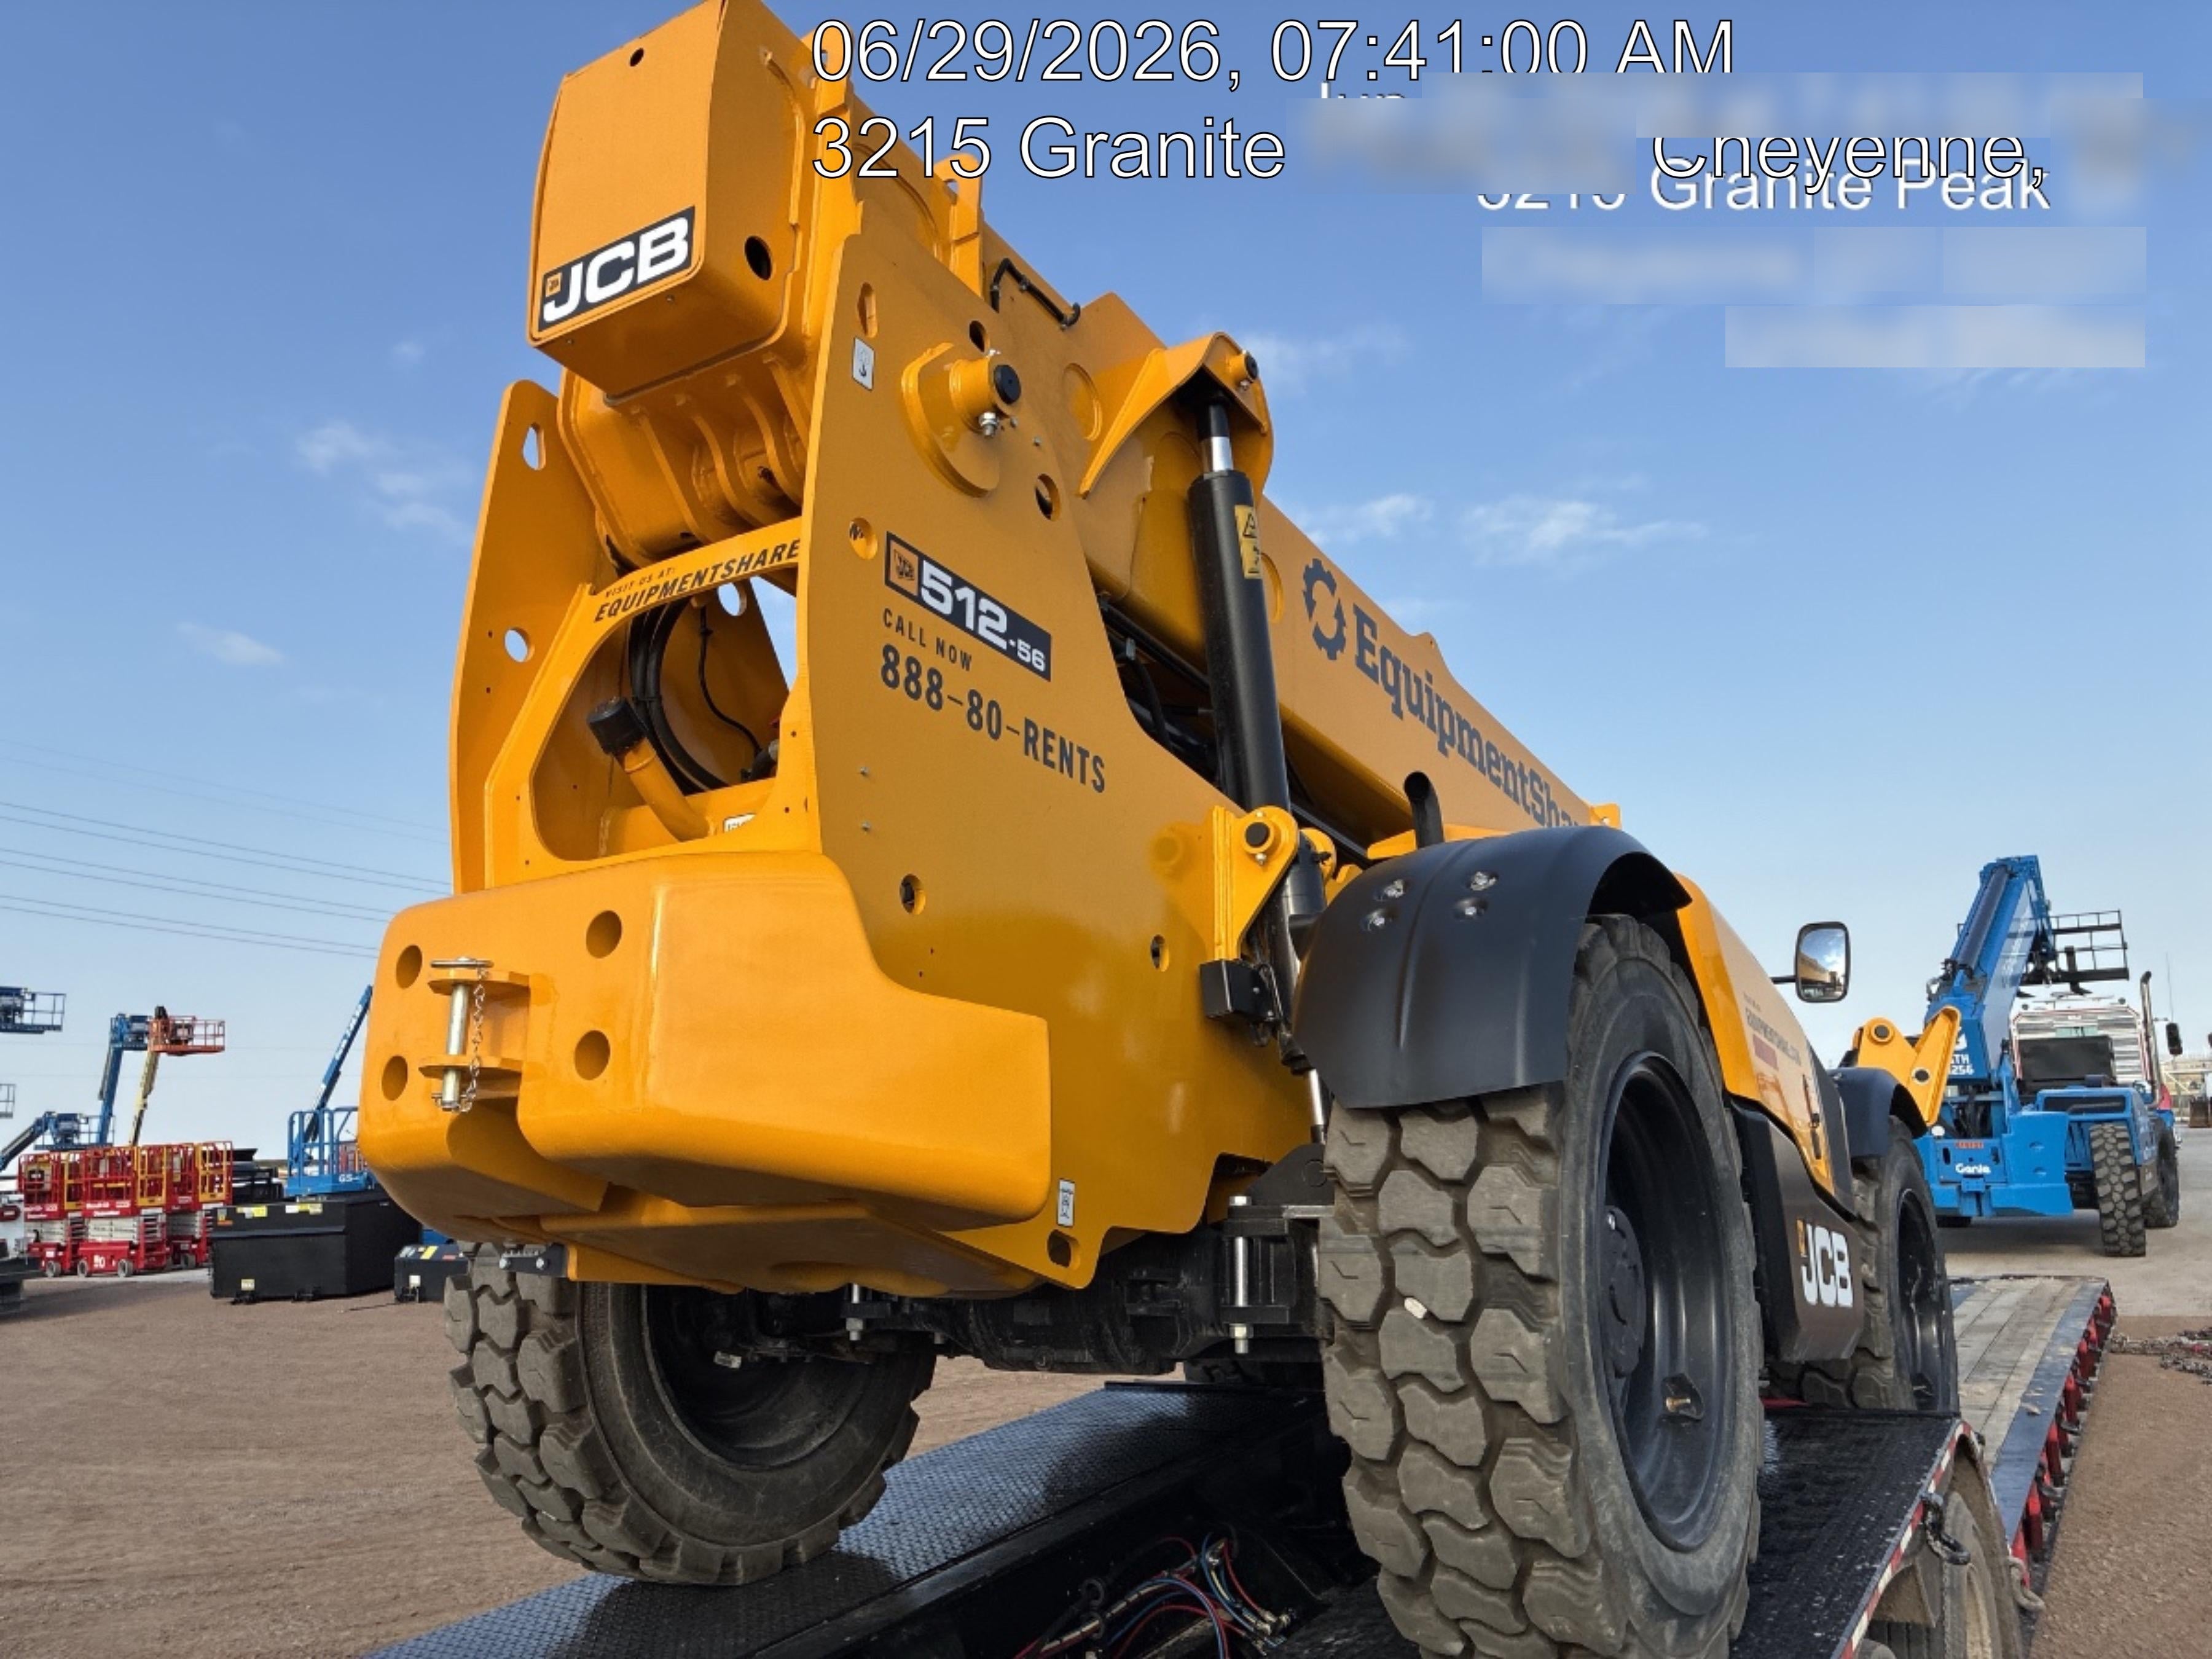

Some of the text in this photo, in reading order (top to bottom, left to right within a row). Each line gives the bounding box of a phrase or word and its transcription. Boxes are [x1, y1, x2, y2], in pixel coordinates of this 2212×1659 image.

[543, 217, 689, 323] JCB
[594, 539, 800, 622] EQUIPMENTSHARE
[883, 608, 973, 671] CALL NOW
[880, 643, 1105, 793] 888-80-RENTS
[1353, 602, 1579, 826] EquipmentSha
[1950, 1053, 1970, 1065] TH
[1800, 1223, 1854, 1308] JCB
